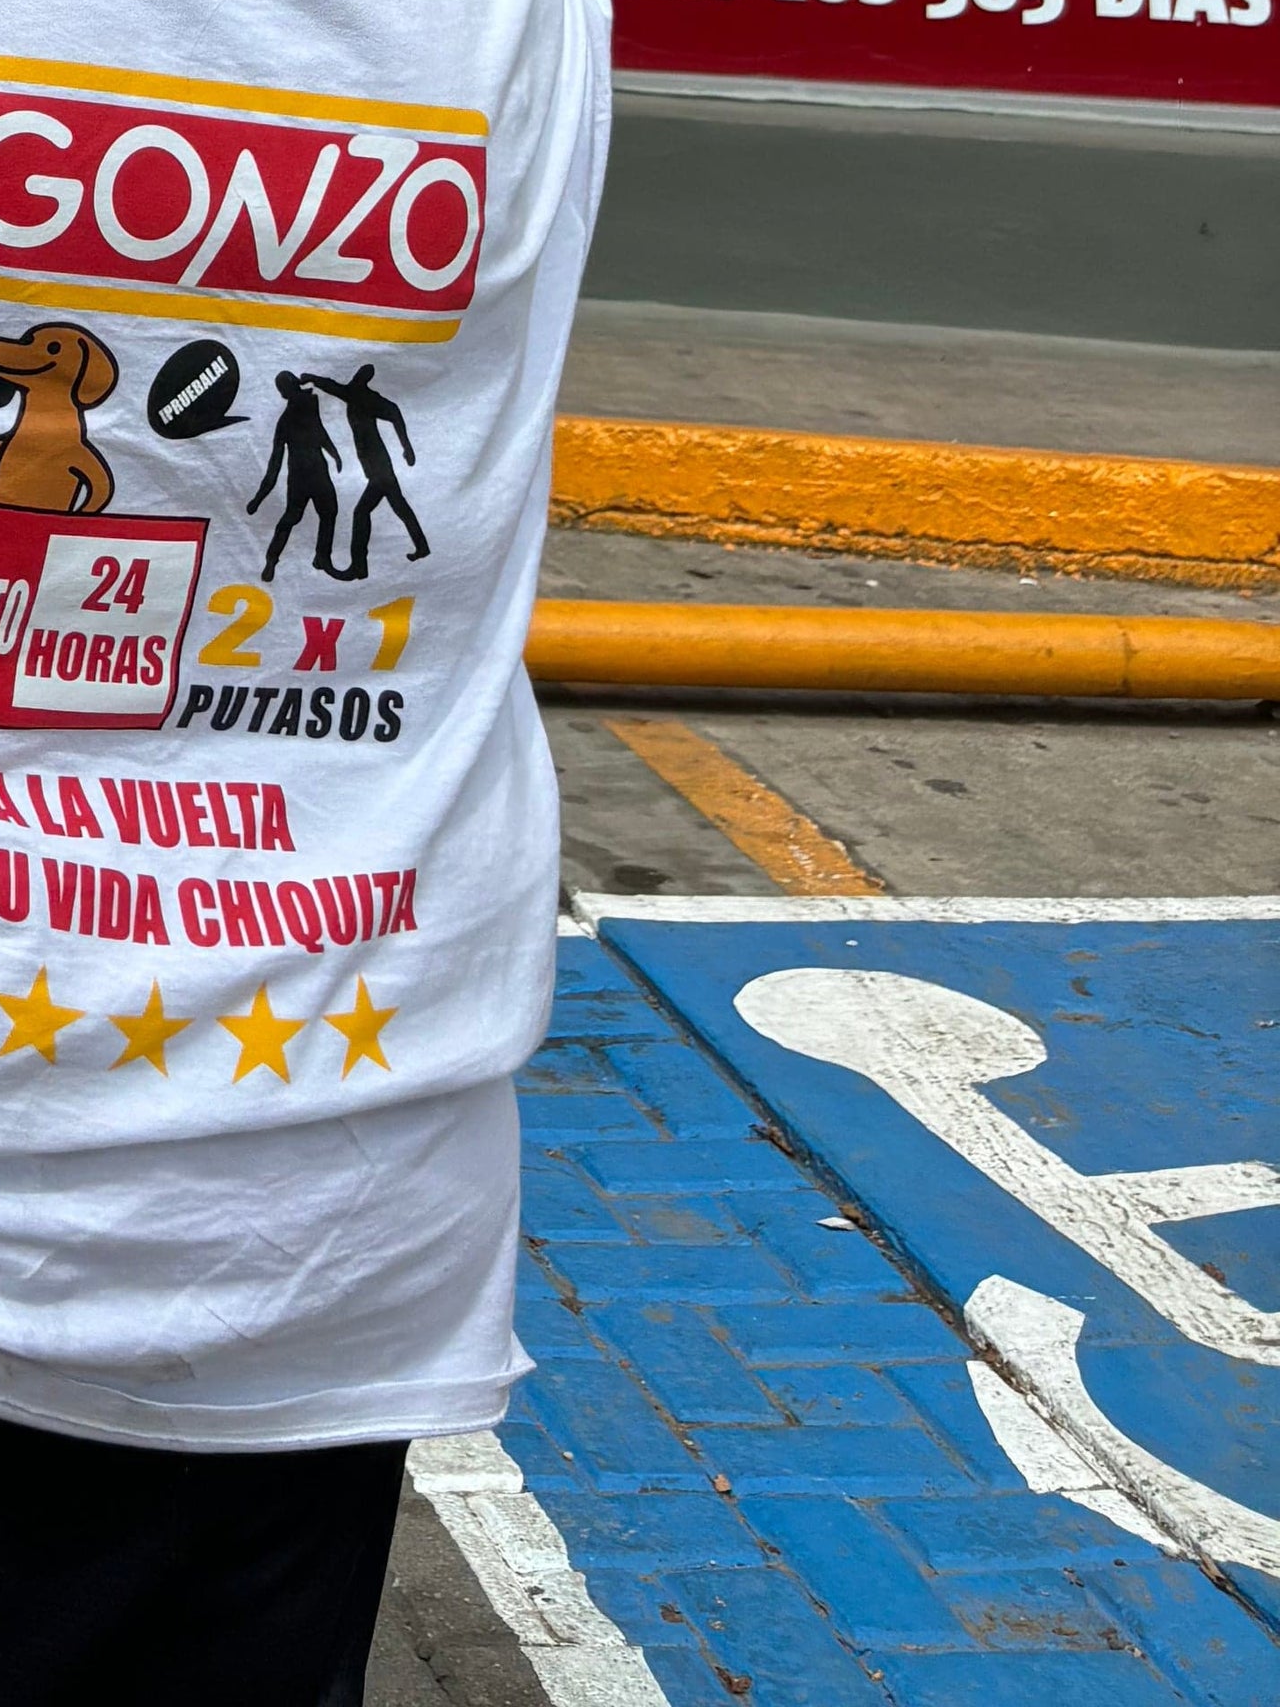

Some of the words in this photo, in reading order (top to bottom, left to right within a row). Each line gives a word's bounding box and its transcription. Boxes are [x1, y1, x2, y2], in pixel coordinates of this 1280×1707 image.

[81, 555, 151, 614] 24
[23, 629, 166, 686] HORAS
[197, 584, 274, 668] 2
[291, 615, 346, 672] x
[367, 596, 416, 672] 1
[176, 683, 405, 743] PUTASOS
[27, 772, 103, 840] LA
[100, 778, 296, 853] VUELTA
[41, 858, 170, 947] VIDA
[177, 868, 418, 954] CHIQUITA
